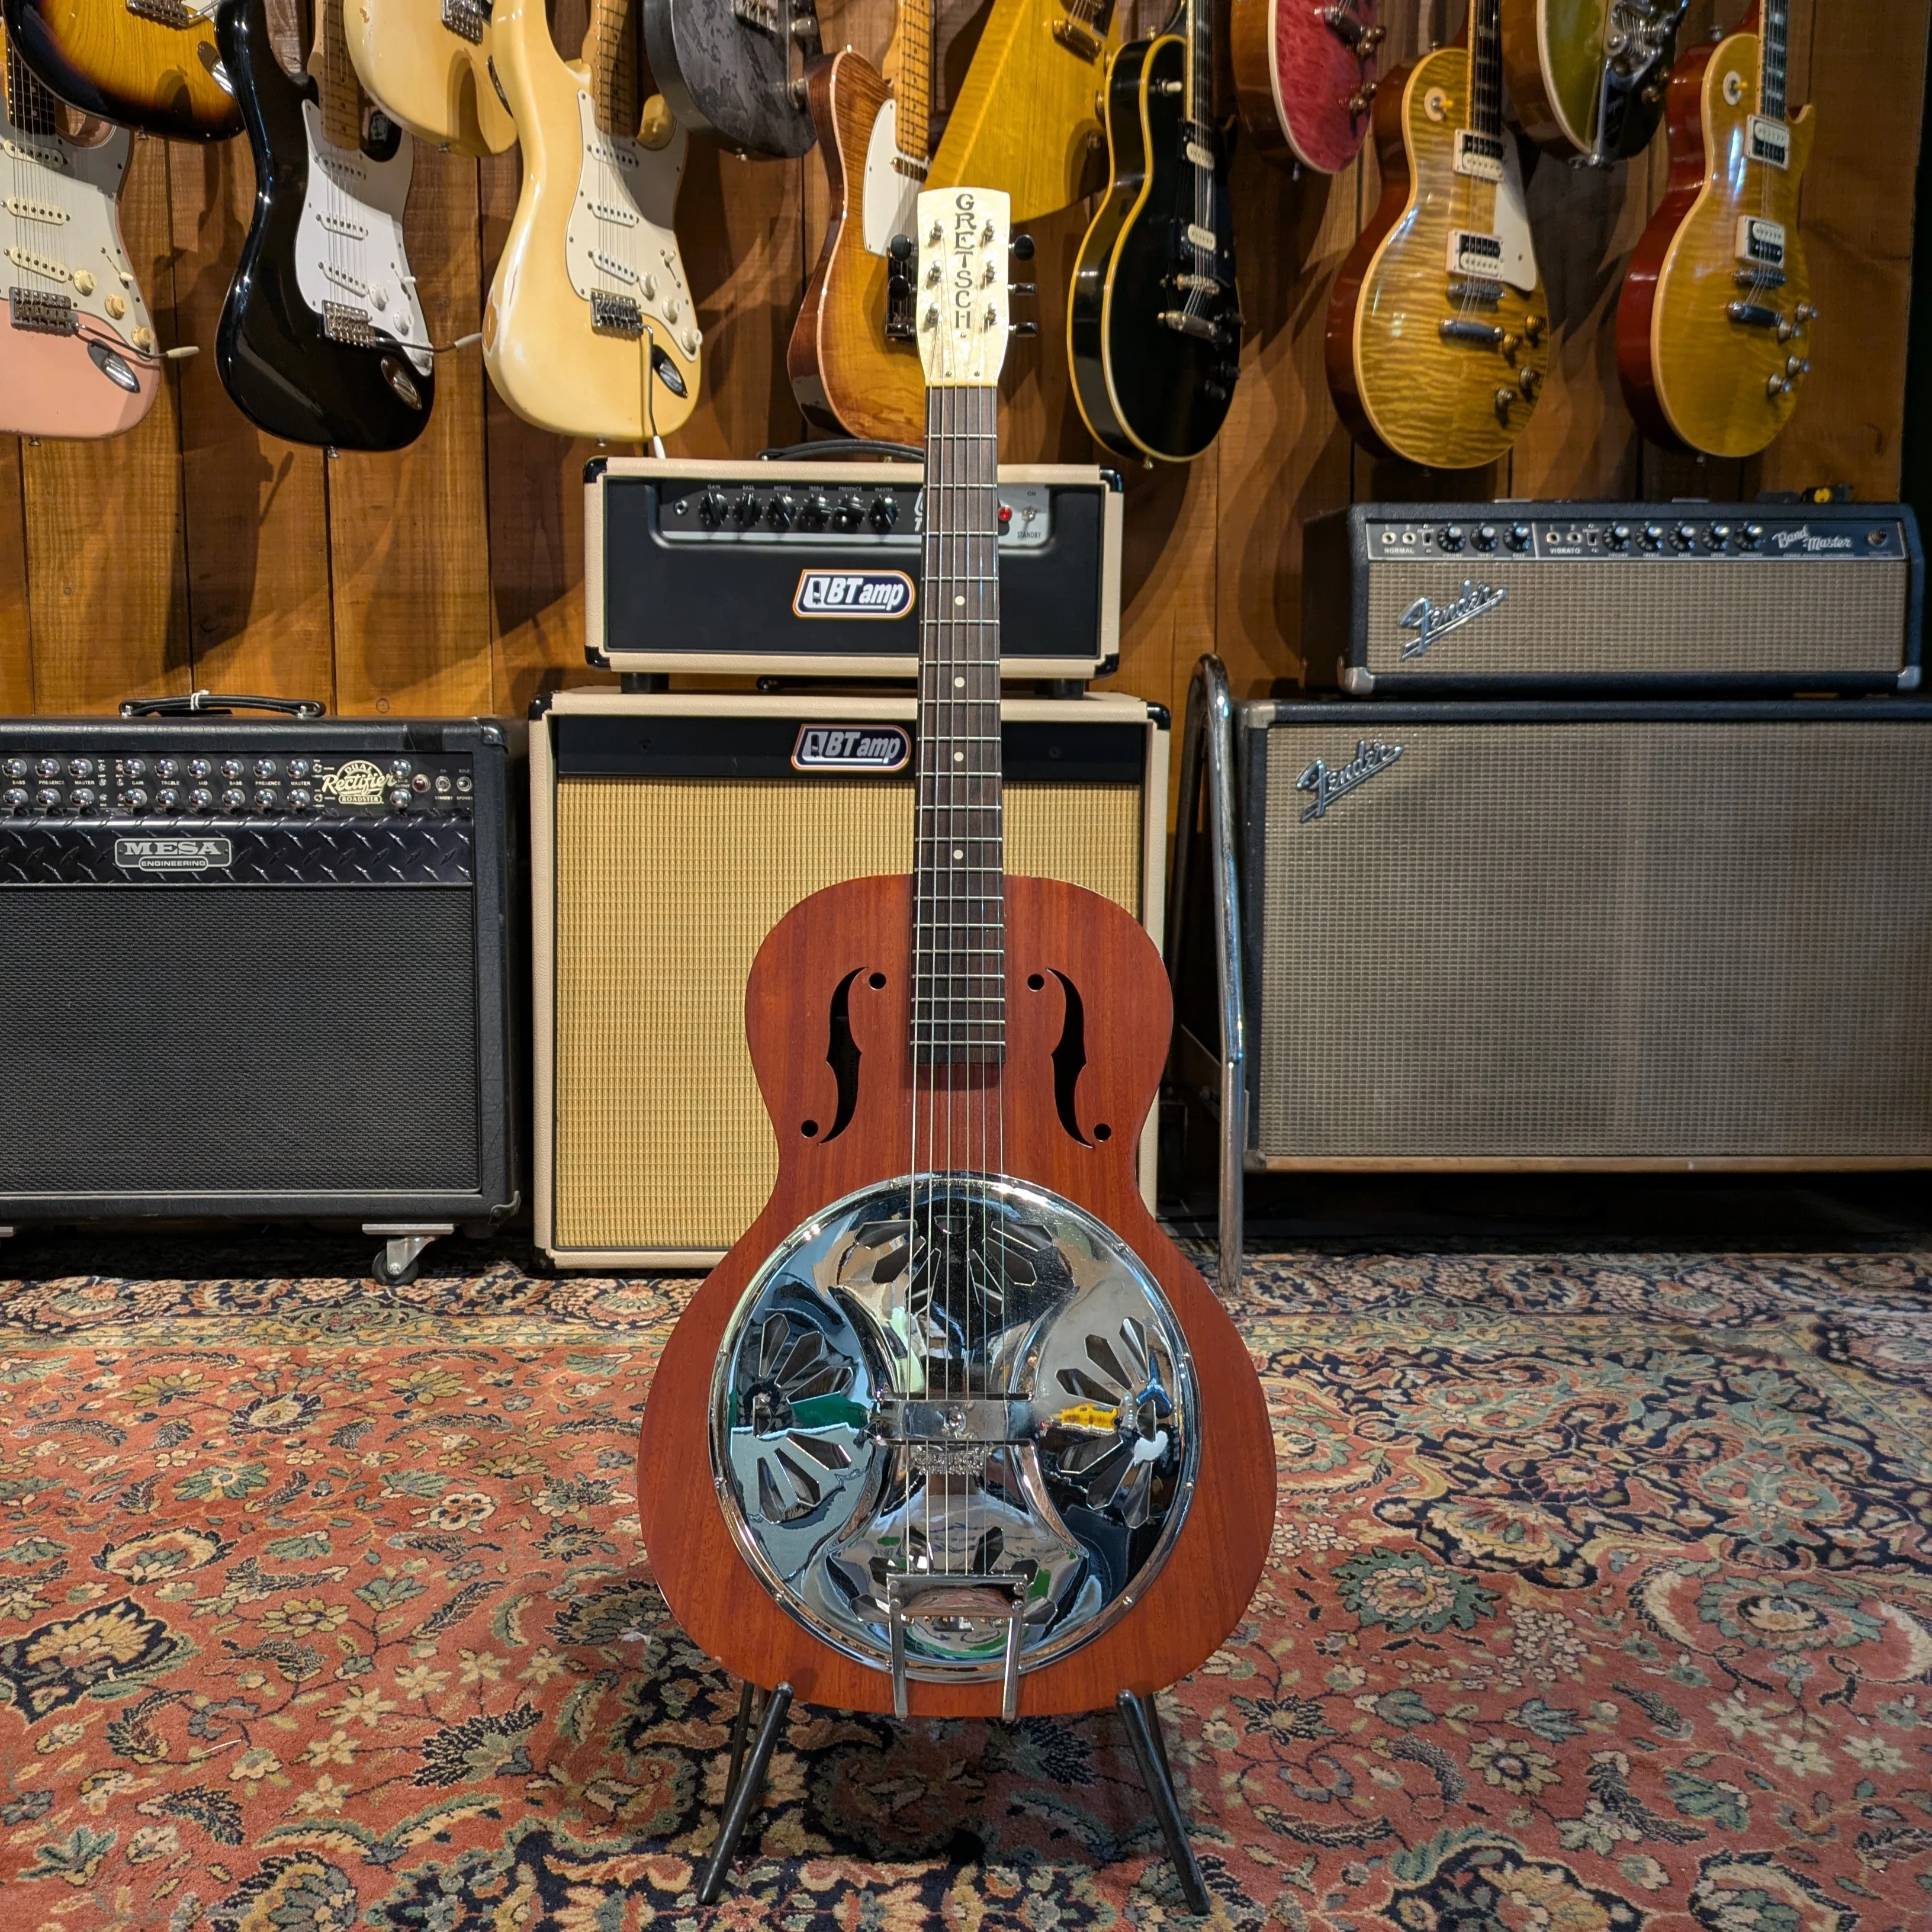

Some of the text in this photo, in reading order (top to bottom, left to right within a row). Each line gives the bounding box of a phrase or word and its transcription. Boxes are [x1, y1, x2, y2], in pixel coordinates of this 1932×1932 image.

[954, 193, 977, 329] GRETSCH
[1772, 523, 1852, 551] Band Master
[827, 577, 905, 611] BT amp
[1399, 579, 1508, 655] Fender
[825, 731, 901, 764] BT amp
[322, 772, 397, 796] Rectifier
[344, 763, 373, 774] DUAL
[1296, 740, 1403, 817] Fender
[124, 841, 221, 855] MESA
